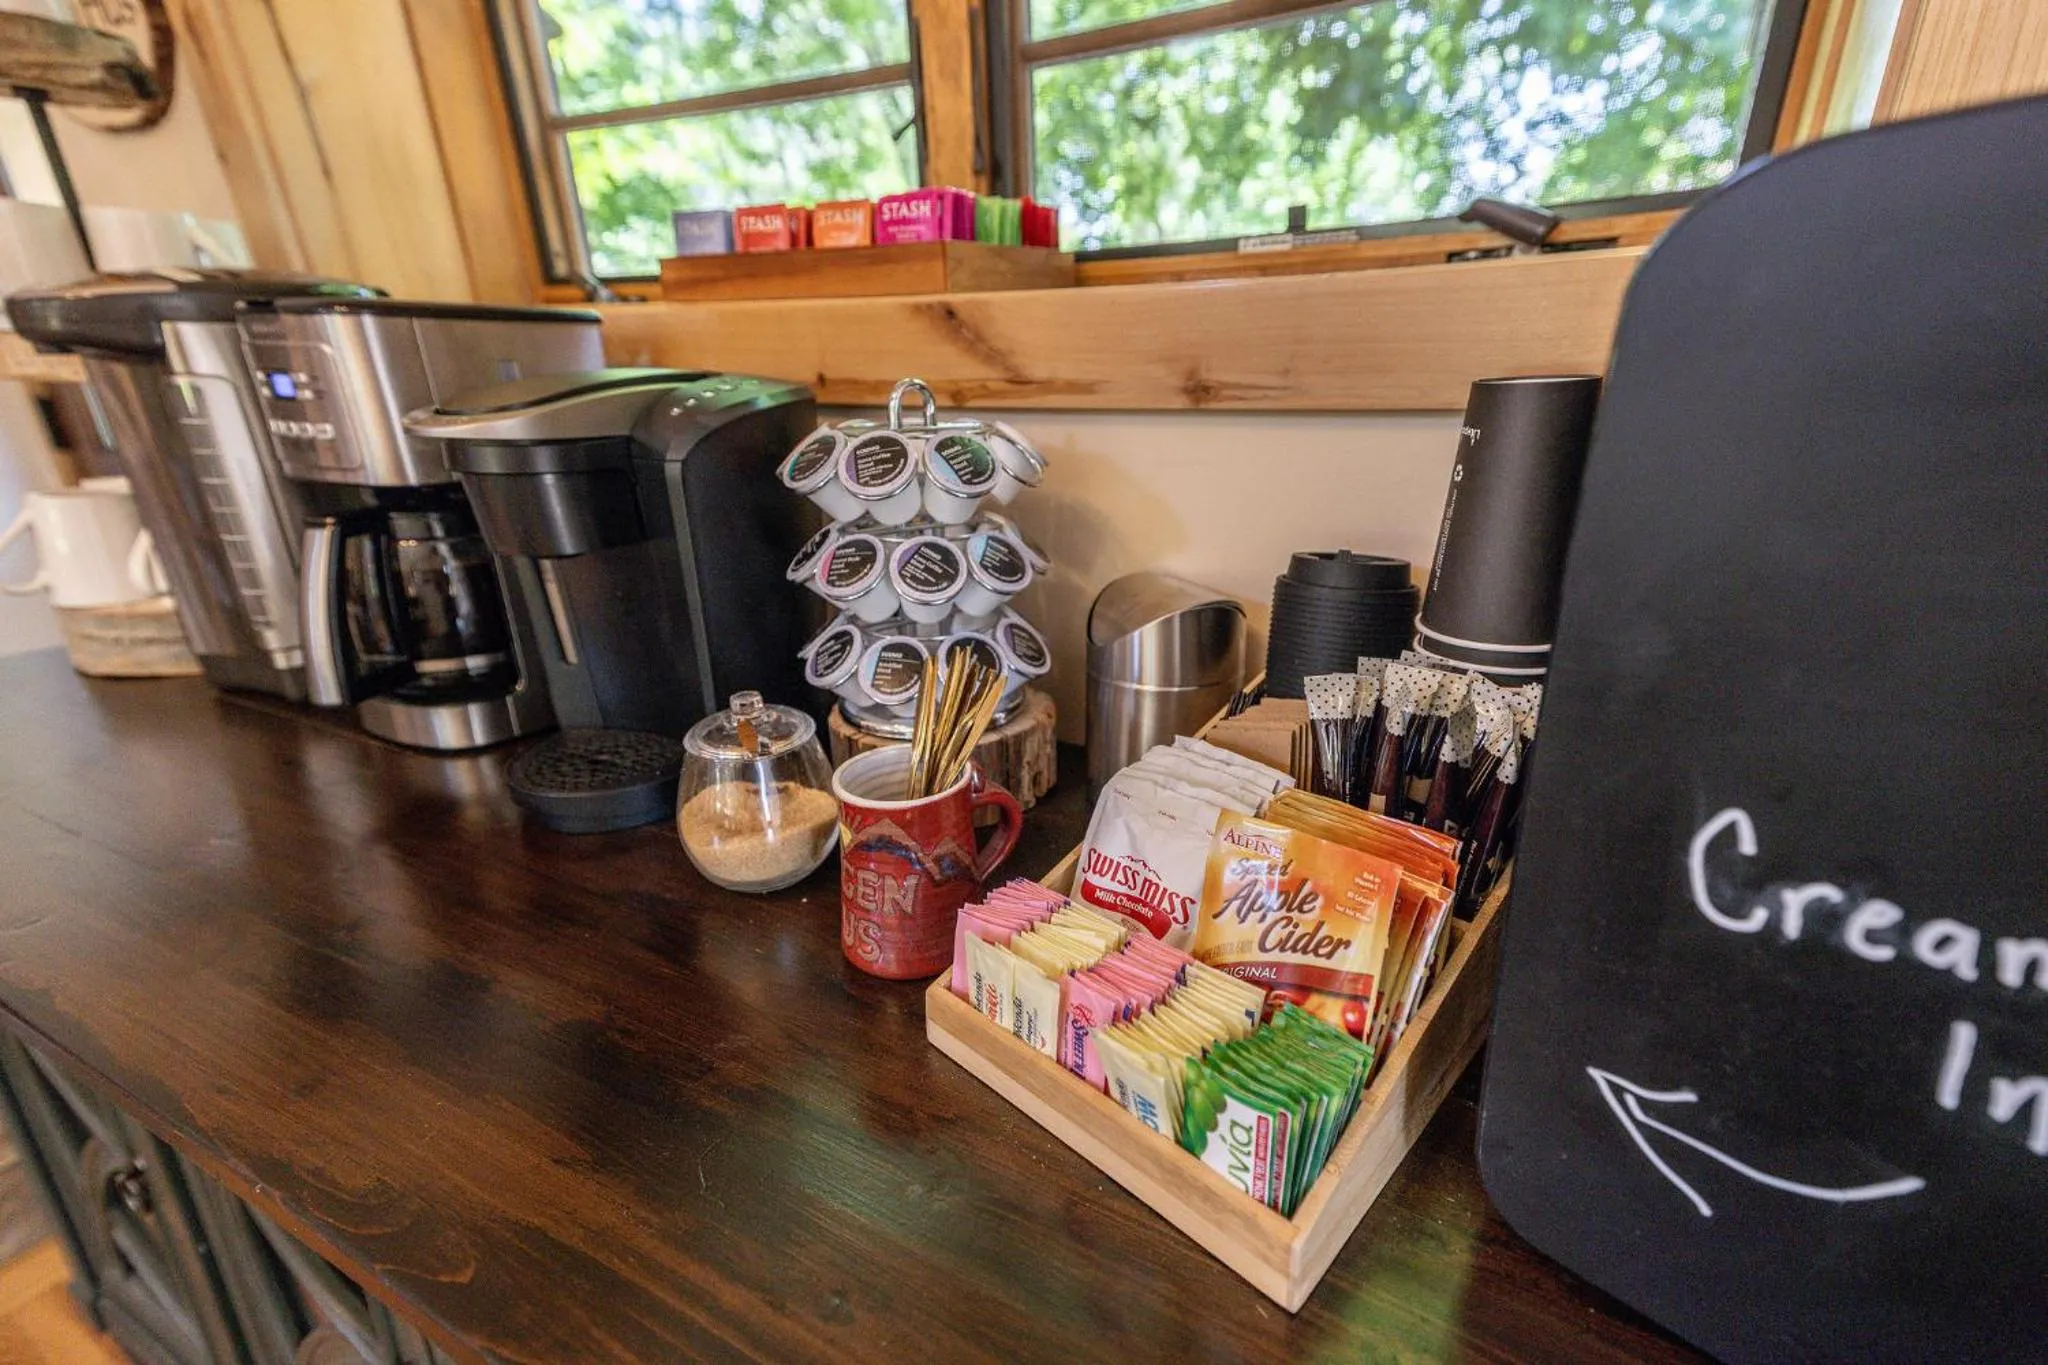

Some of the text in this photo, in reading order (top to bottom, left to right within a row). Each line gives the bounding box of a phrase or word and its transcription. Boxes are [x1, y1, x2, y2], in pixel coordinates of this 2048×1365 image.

[817, 208, 863, 226] STASH
[881, 200, 931, 222] STASH
[1082, 847, 1196, 925] SWISS MISS
[1094, 888, 1116, 903] Milk
[1116, 895, 1153, 918] Chocolate
[1212, 878, 1320, 924] Apple
[1258, 915, 1352, 960] Cider
